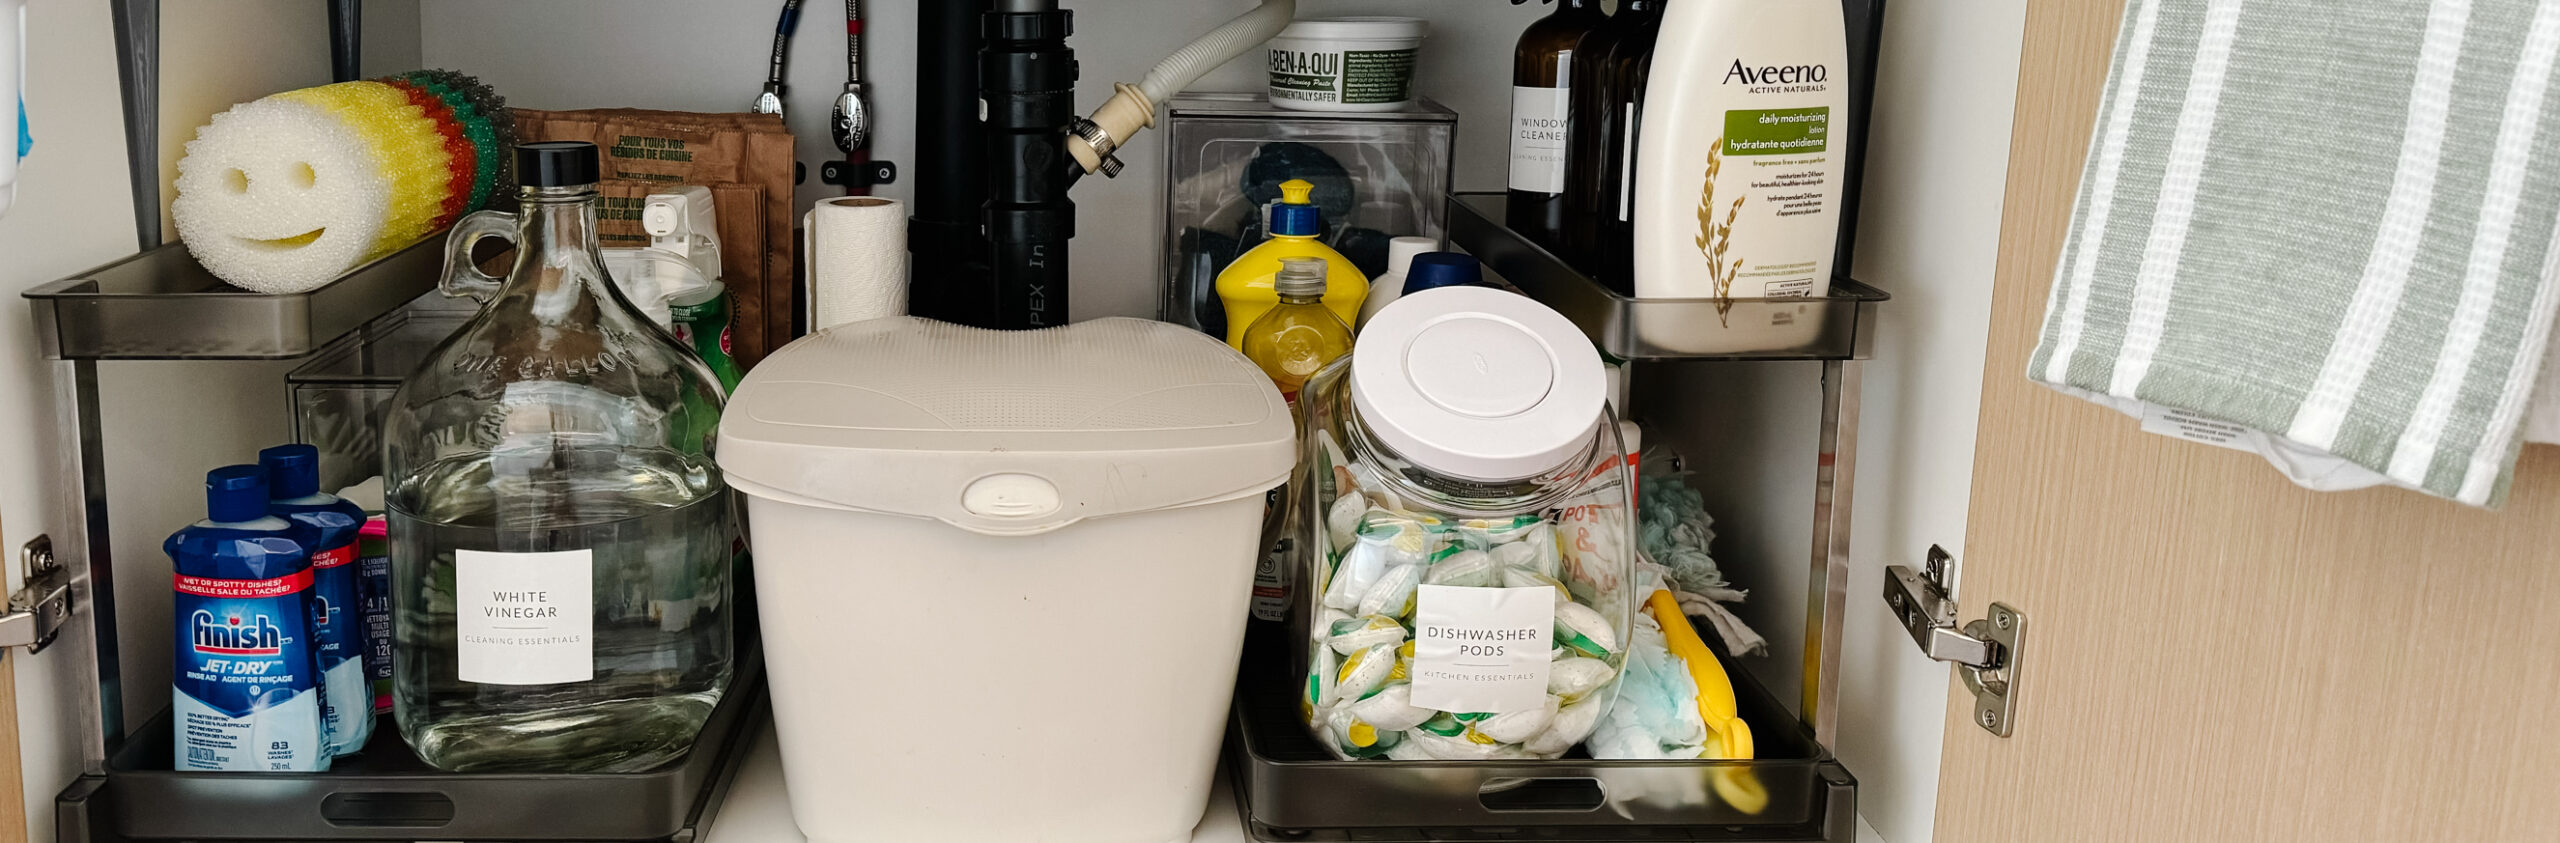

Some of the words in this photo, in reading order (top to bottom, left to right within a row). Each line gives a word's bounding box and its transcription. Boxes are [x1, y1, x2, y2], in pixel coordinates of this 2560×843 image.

[1287, 77, 1311, 87] Cleaning
[1313, 78, 1331, 87] Paste
[1748, 86, 1781, 94] ACTIVE
[1313, 92, 1337, 103] SAFER
[1759, 113, 1779, 125] daily
[1780, 112, 1826, 123] moisturizing
[1808, 125, 1824, 134] lotion
[619, 135, 641, 147] POUR
[643, 136, 666, 148] TOUS
[668, 139, 685, 149] VOS
[1730, 139, 1778, 151] hydratante
[1780, 137, 1824, 150] quotidienne
[646, 149, 658, 160] DE
[659, 150, 693, 162] CUISINE
[608, 197, 629, 208] TOUS
[610, 209, 622, 220] DE
[518, 347, 641, 379] GALLON
[213, 580, 245, 588] SPOTTY
[247, 578, 282, 588] DISHES?
[178, 583, 215, 594] VAISSELLE
[217, 588, 239, 596] SALE
[493, 591, 547, 603] WHITE
[484, 606, 558, 619] VINEGAR
[192, 609, 281, 652] finish
[1428, 627, 1537, 641] DISHWASHER
[465, 635, 513, 645] CLEANING
[518, 635, 581, 645] ESSENTIALS
[1460, 645, 1504, 657] PODS
[200, 659, 272, 675] JET-DRY
[187, 671, 204, 680] RINSE
[222, 675, 246, 683] AGENT
[259, 675, 293, 684] RINÇAGE
[1424, 670, 1469, 681] KITCHEN
[1475, 673, 1534, 682] ESSENTIALS
[271, 741, 289, 750] 83
[271, 762, 280, 770] 250
